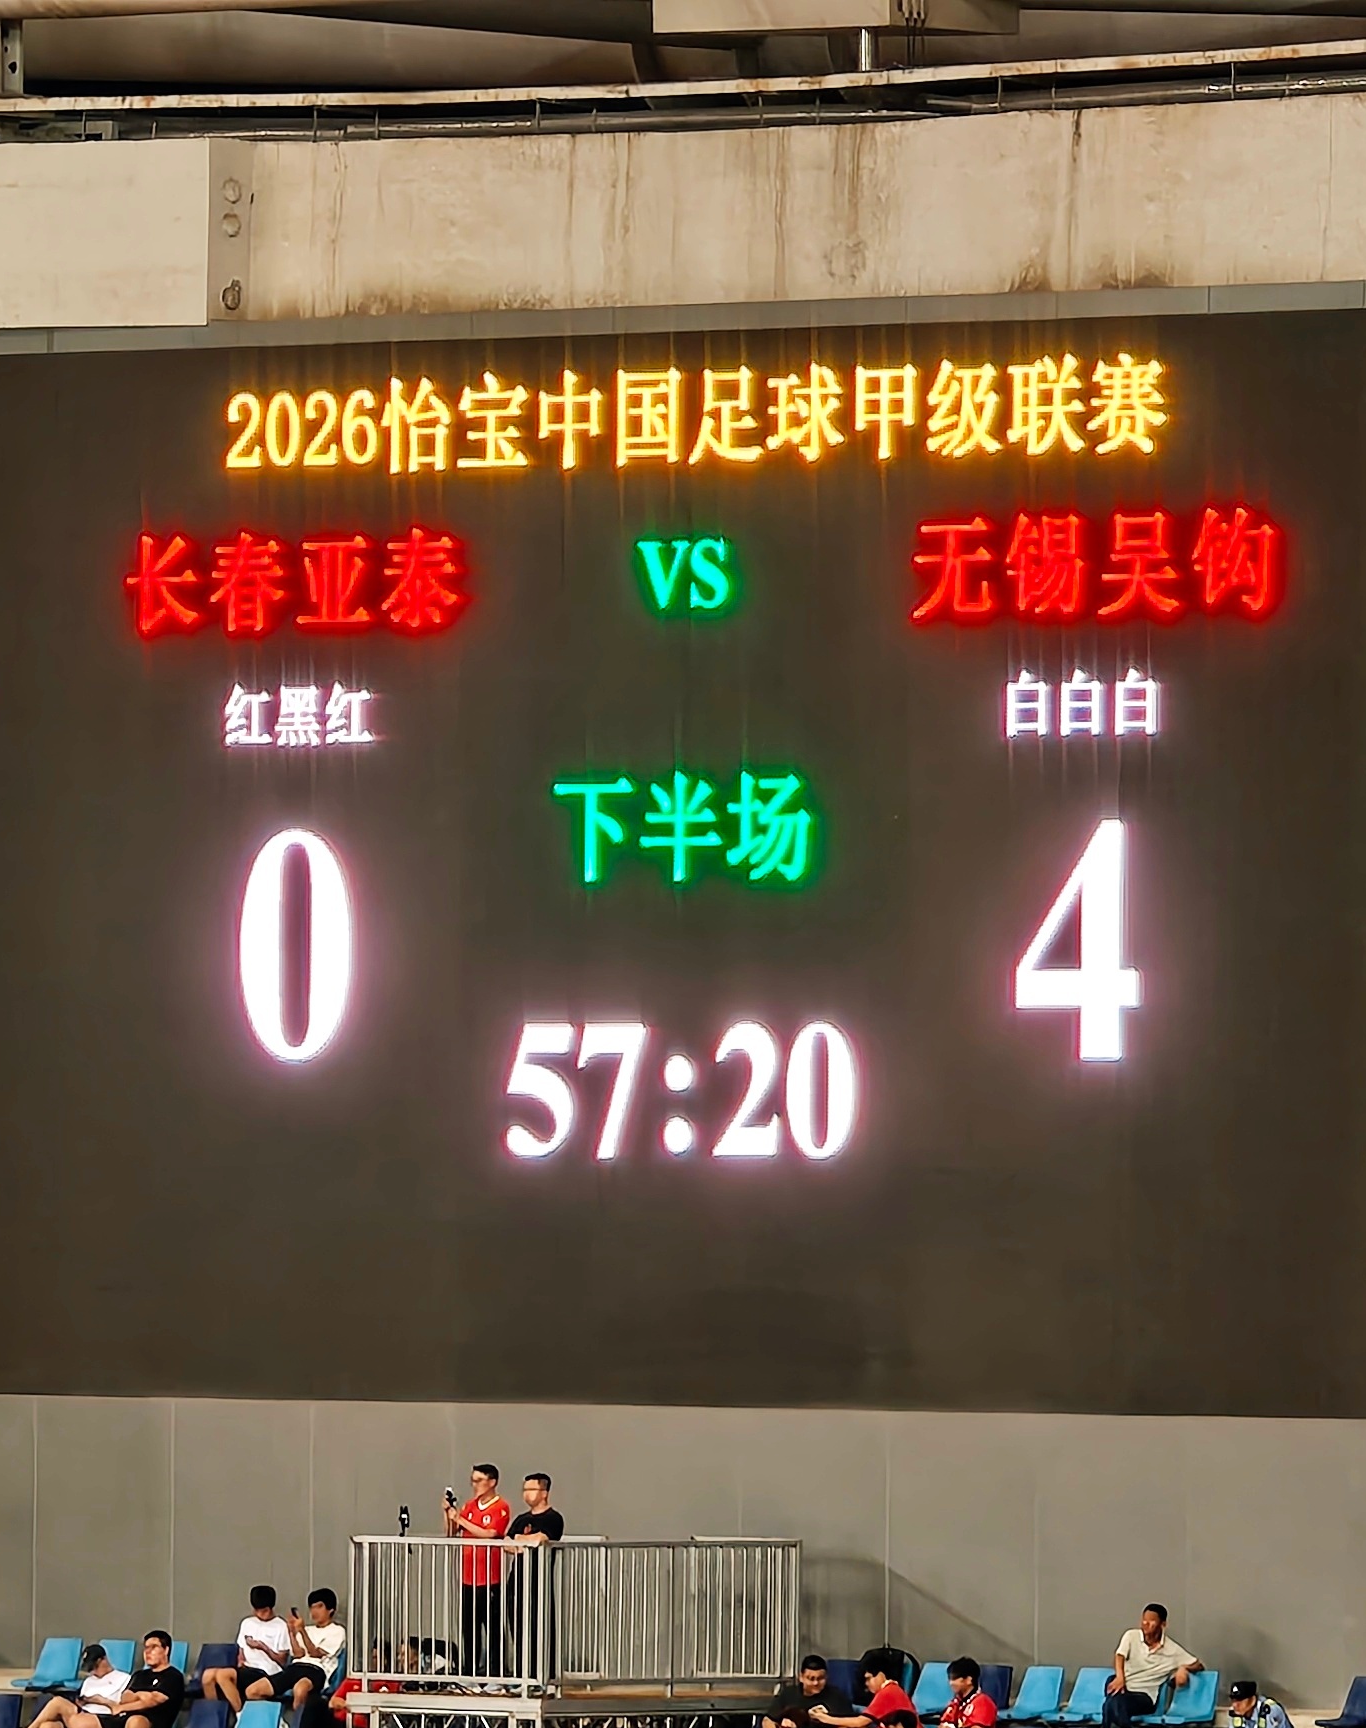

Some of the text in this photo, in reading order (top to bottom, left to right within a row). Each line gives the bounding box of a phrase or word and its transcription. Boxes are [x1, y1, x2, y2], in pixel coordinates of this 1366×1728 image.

[226, 354, 1170, 472] 2026怡宝中国足球甲级联赛
[125, 526, 469, 637] 长春亚泰
[637, 535, 731, 613] VS
[911, 508, 1280, 625] 无锡吴钩
[223, 684, 374, 748] 红黑红
[1004, 668, 1162, 739] 白白白
[552, 772, 816, 884] 下半场
[237, 829, 353, 1063] 0
[1014, 818, 1143, 1062] 4
[503, 1022, 862, 1160] 57:20
